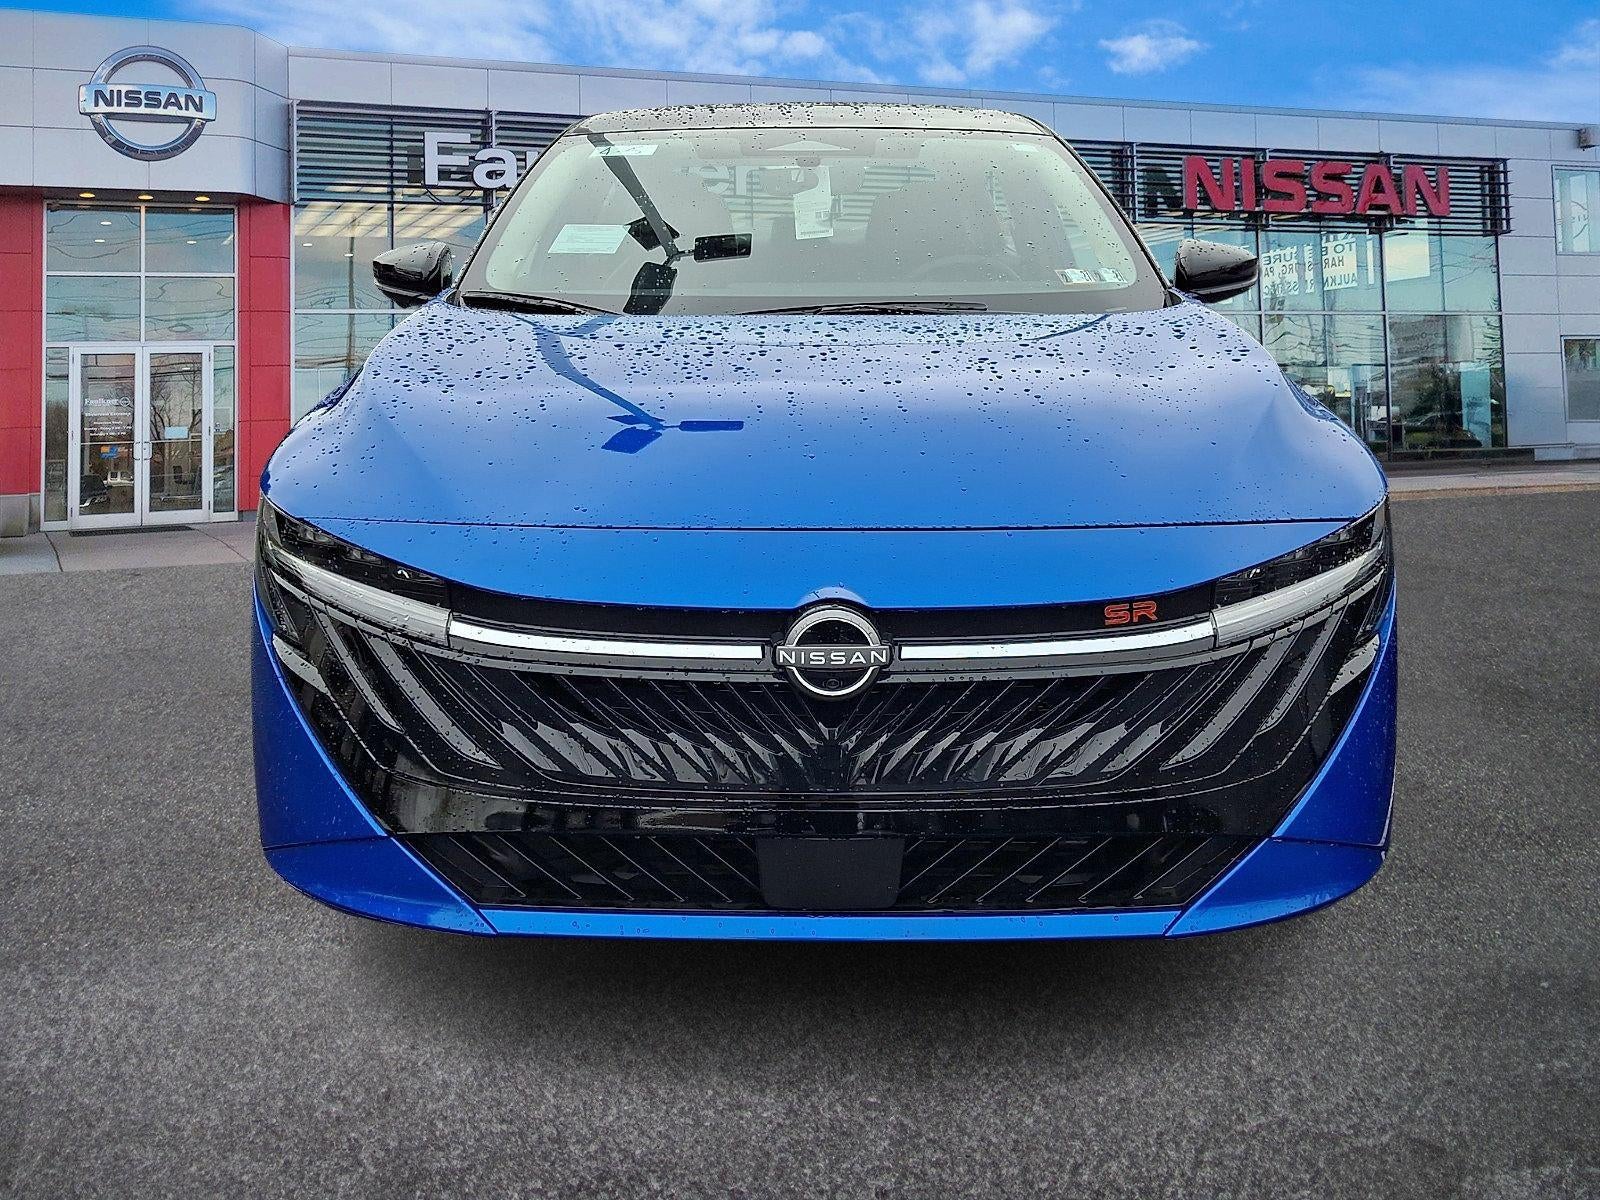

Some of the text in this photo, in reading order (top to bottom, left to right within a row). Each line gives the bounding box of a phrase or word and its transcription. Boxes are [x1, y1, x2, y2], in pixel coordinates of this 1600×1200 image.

[93, 89, 204, 113] NISSAN
[1182, 155, 1450, 216] NISSAN
[1104, 600, 1158, 625] SR
[779, 649, 887, 665] NISSAN
